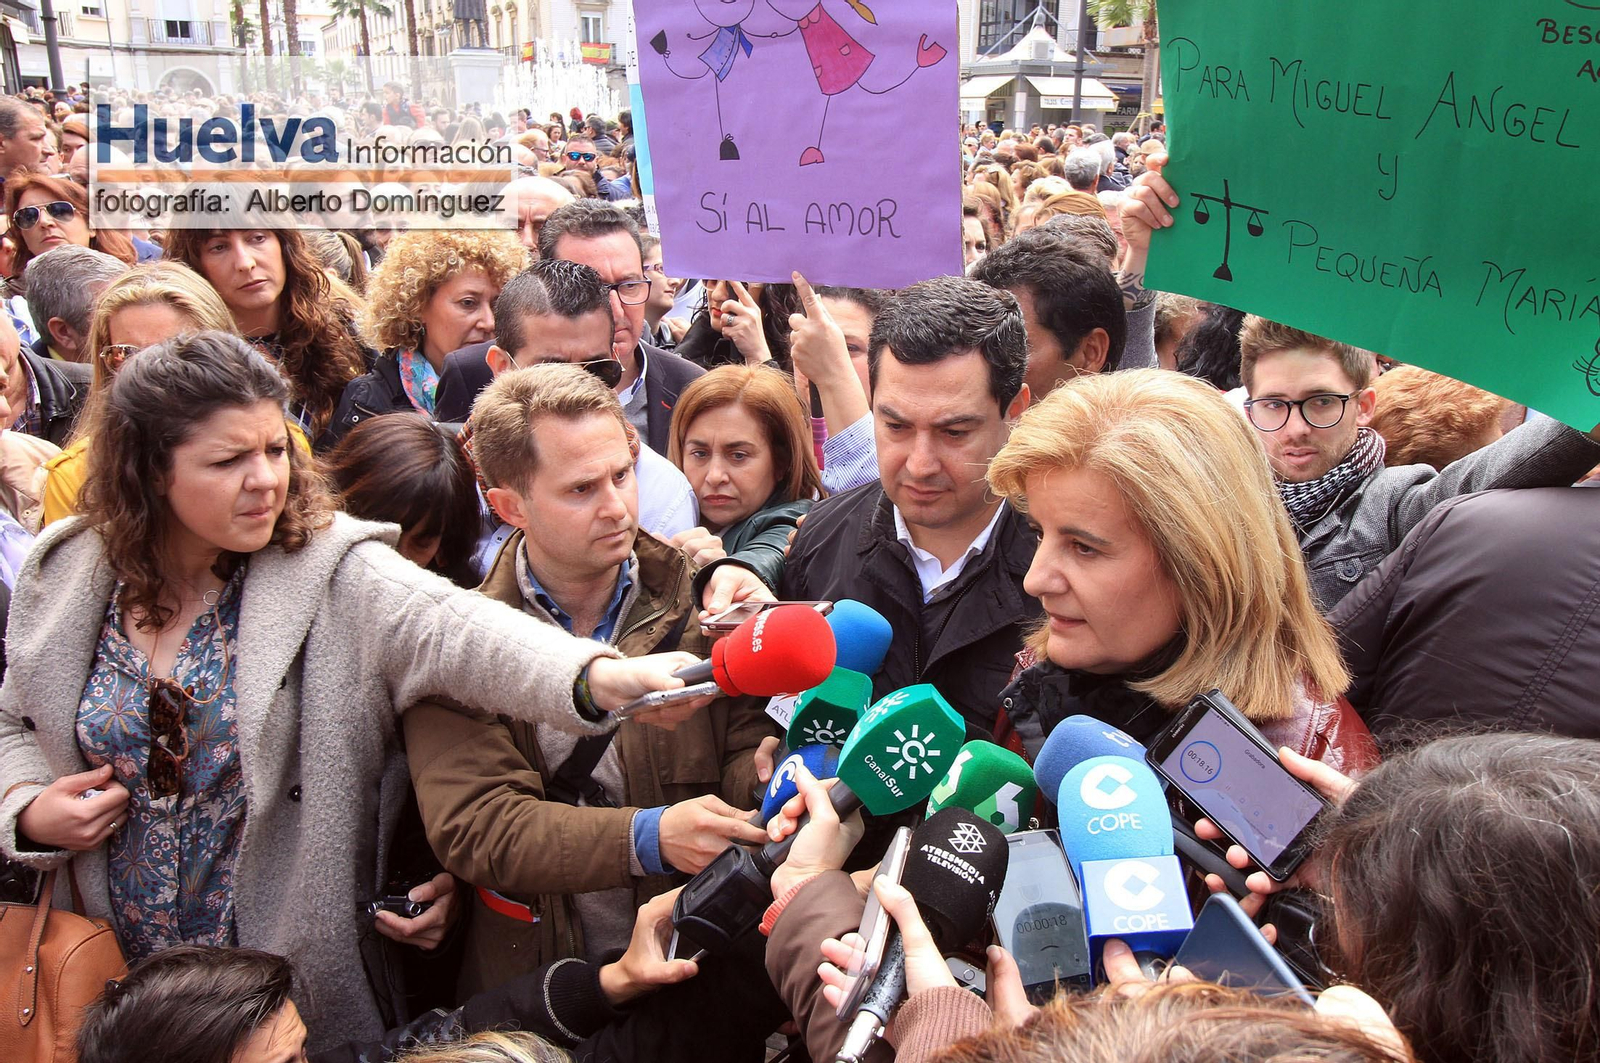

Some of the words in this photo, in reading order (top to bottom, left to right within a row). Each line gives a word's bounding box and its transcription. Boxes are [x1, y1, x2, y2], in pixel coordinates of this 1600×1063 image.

[1576, 59, 1600, 83] A
[1167, 37, 1250, 102] PARA
[1415, 71, 1580, 148] ANGEL
[1117, 106, 1139, 116] FARM
[746, 202, 785, 234] AL
[805, 199, 901, 238] AMOR
[1282, 219, 1443, 298] PEQUEÑA
[771, 705, 791, 723] ATL
[1087, 813, 1142, 835] COPE
[920, 843, 985, 885] ATRESMEDIA
[926, 853, 975, 884] TELEVISIÓN
[1016, 914, 1067, 934] 00:00:18
[1113, 913, 1169, 932] COPE
